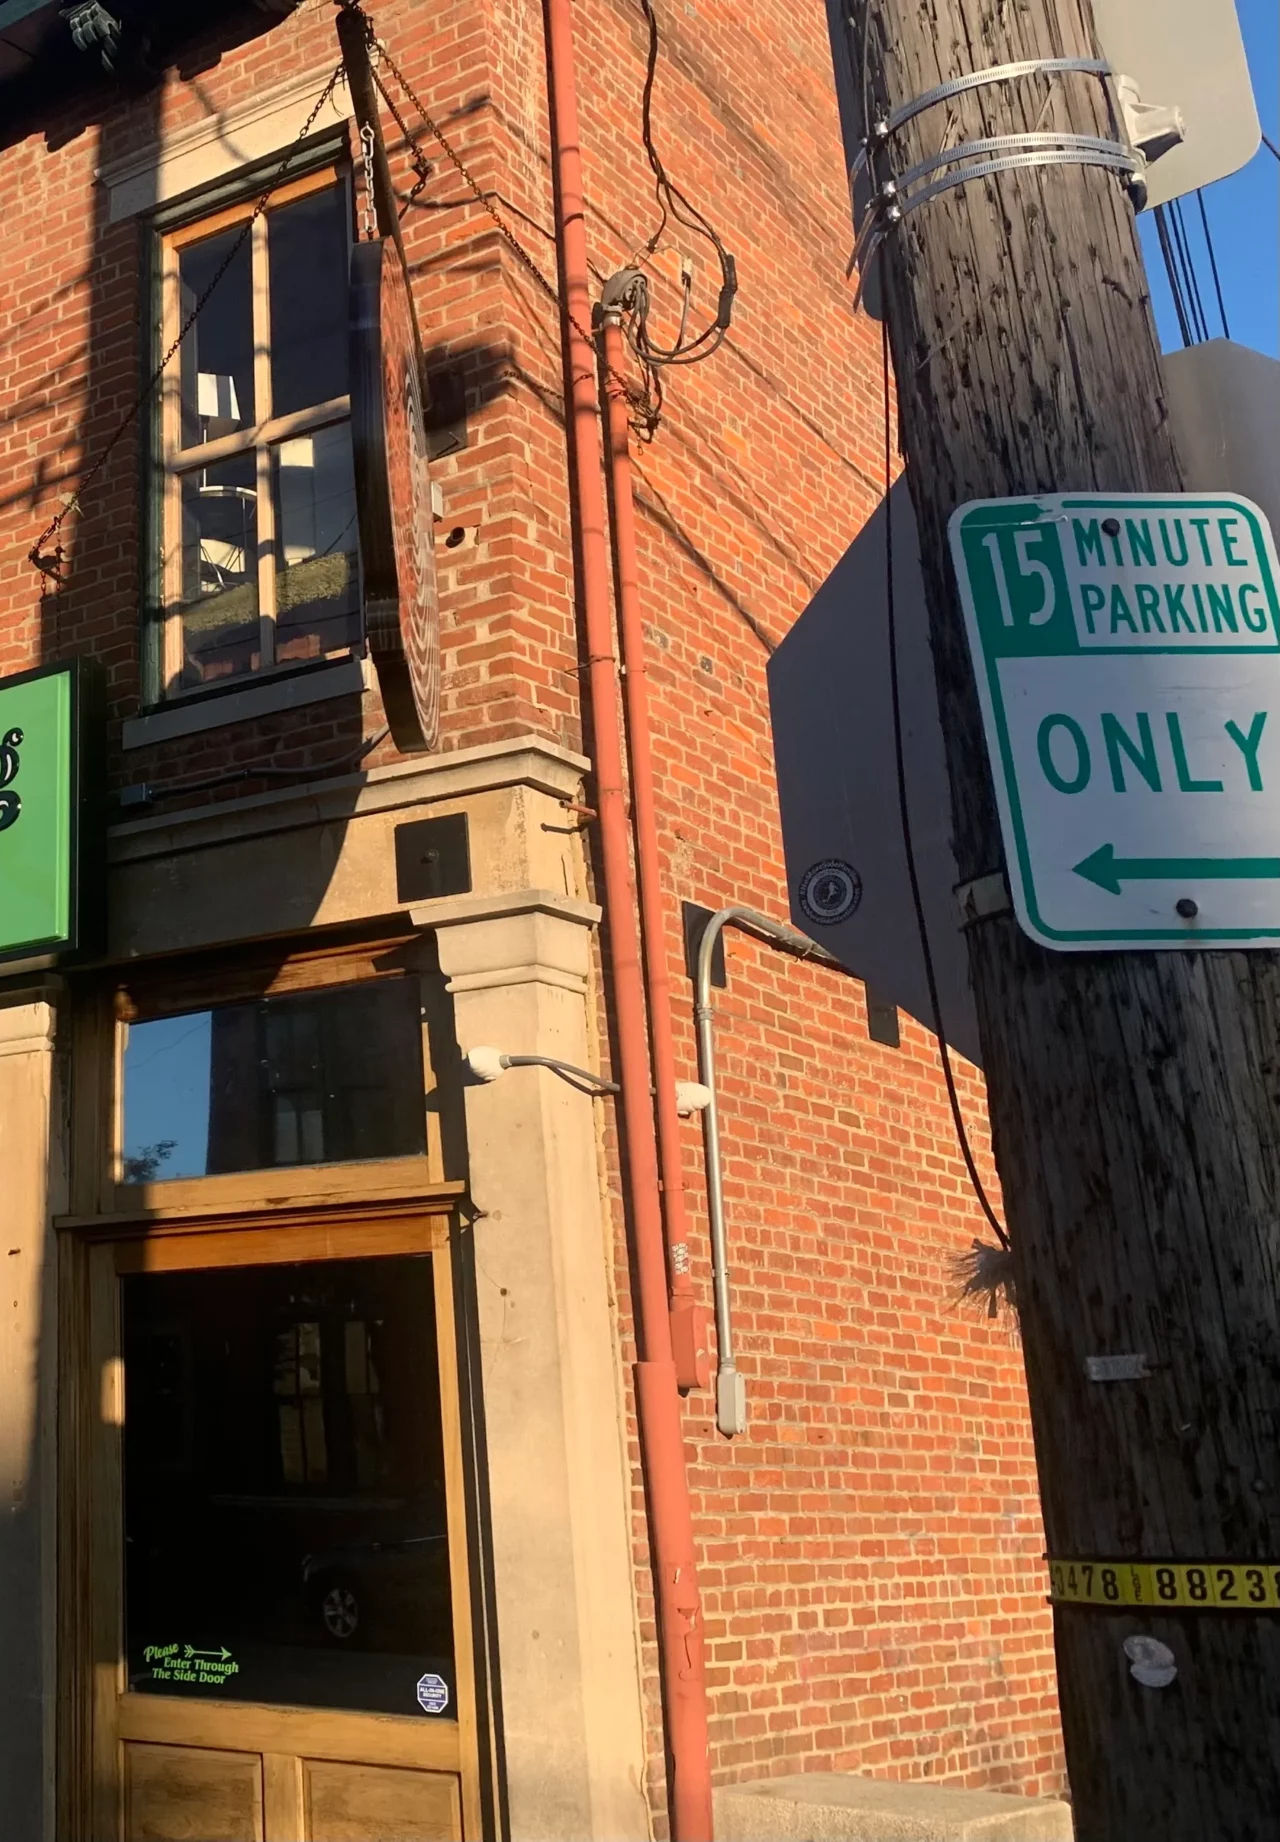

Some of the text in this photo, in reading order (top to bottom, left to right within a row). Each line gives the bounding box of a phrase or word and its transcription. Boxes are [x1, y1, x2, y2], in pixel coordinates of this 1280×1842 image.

[1072, 518, 1248, 567] MINUTE
[981, 529, 1056, 627] 15
[1080, 583, 1268, 634] PARKING
[1037, 711, 1268, 795] ONLY
[1051, 1565, 1119, 1600] 3478
[143, 1643, 179, 1662] Please
[164, 1657, 239, 1675] Enter Through
[152, 1668, 226, 1684] The Side Door
